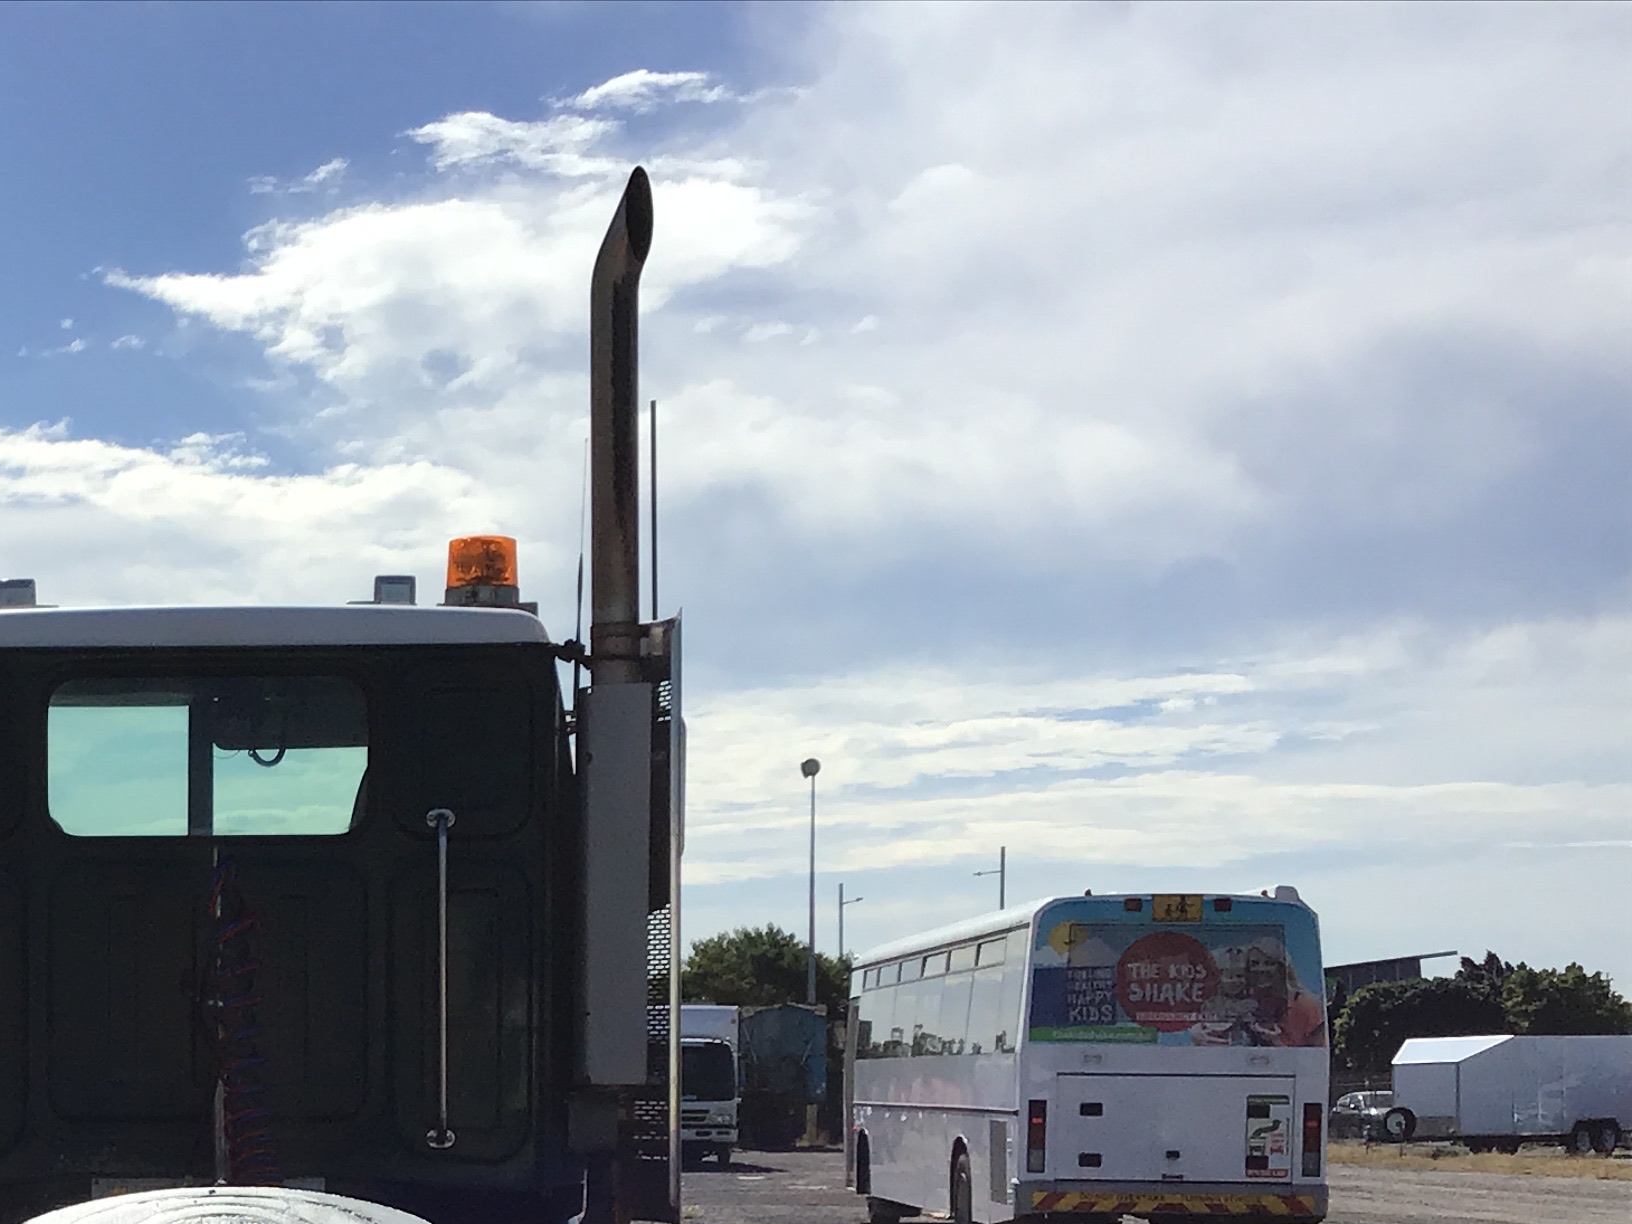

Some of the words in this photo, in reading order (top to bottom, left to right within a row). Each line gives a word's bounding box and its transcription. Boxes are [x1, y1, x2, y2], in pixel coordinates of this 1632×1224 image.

[1128, 963, 1160, 979] THE
[1169, 963, 1207, 979] KIDS
[1128, 982, 1206, 1006] SHAKE
[1069, 1004, 1113, 1023] KIDS
